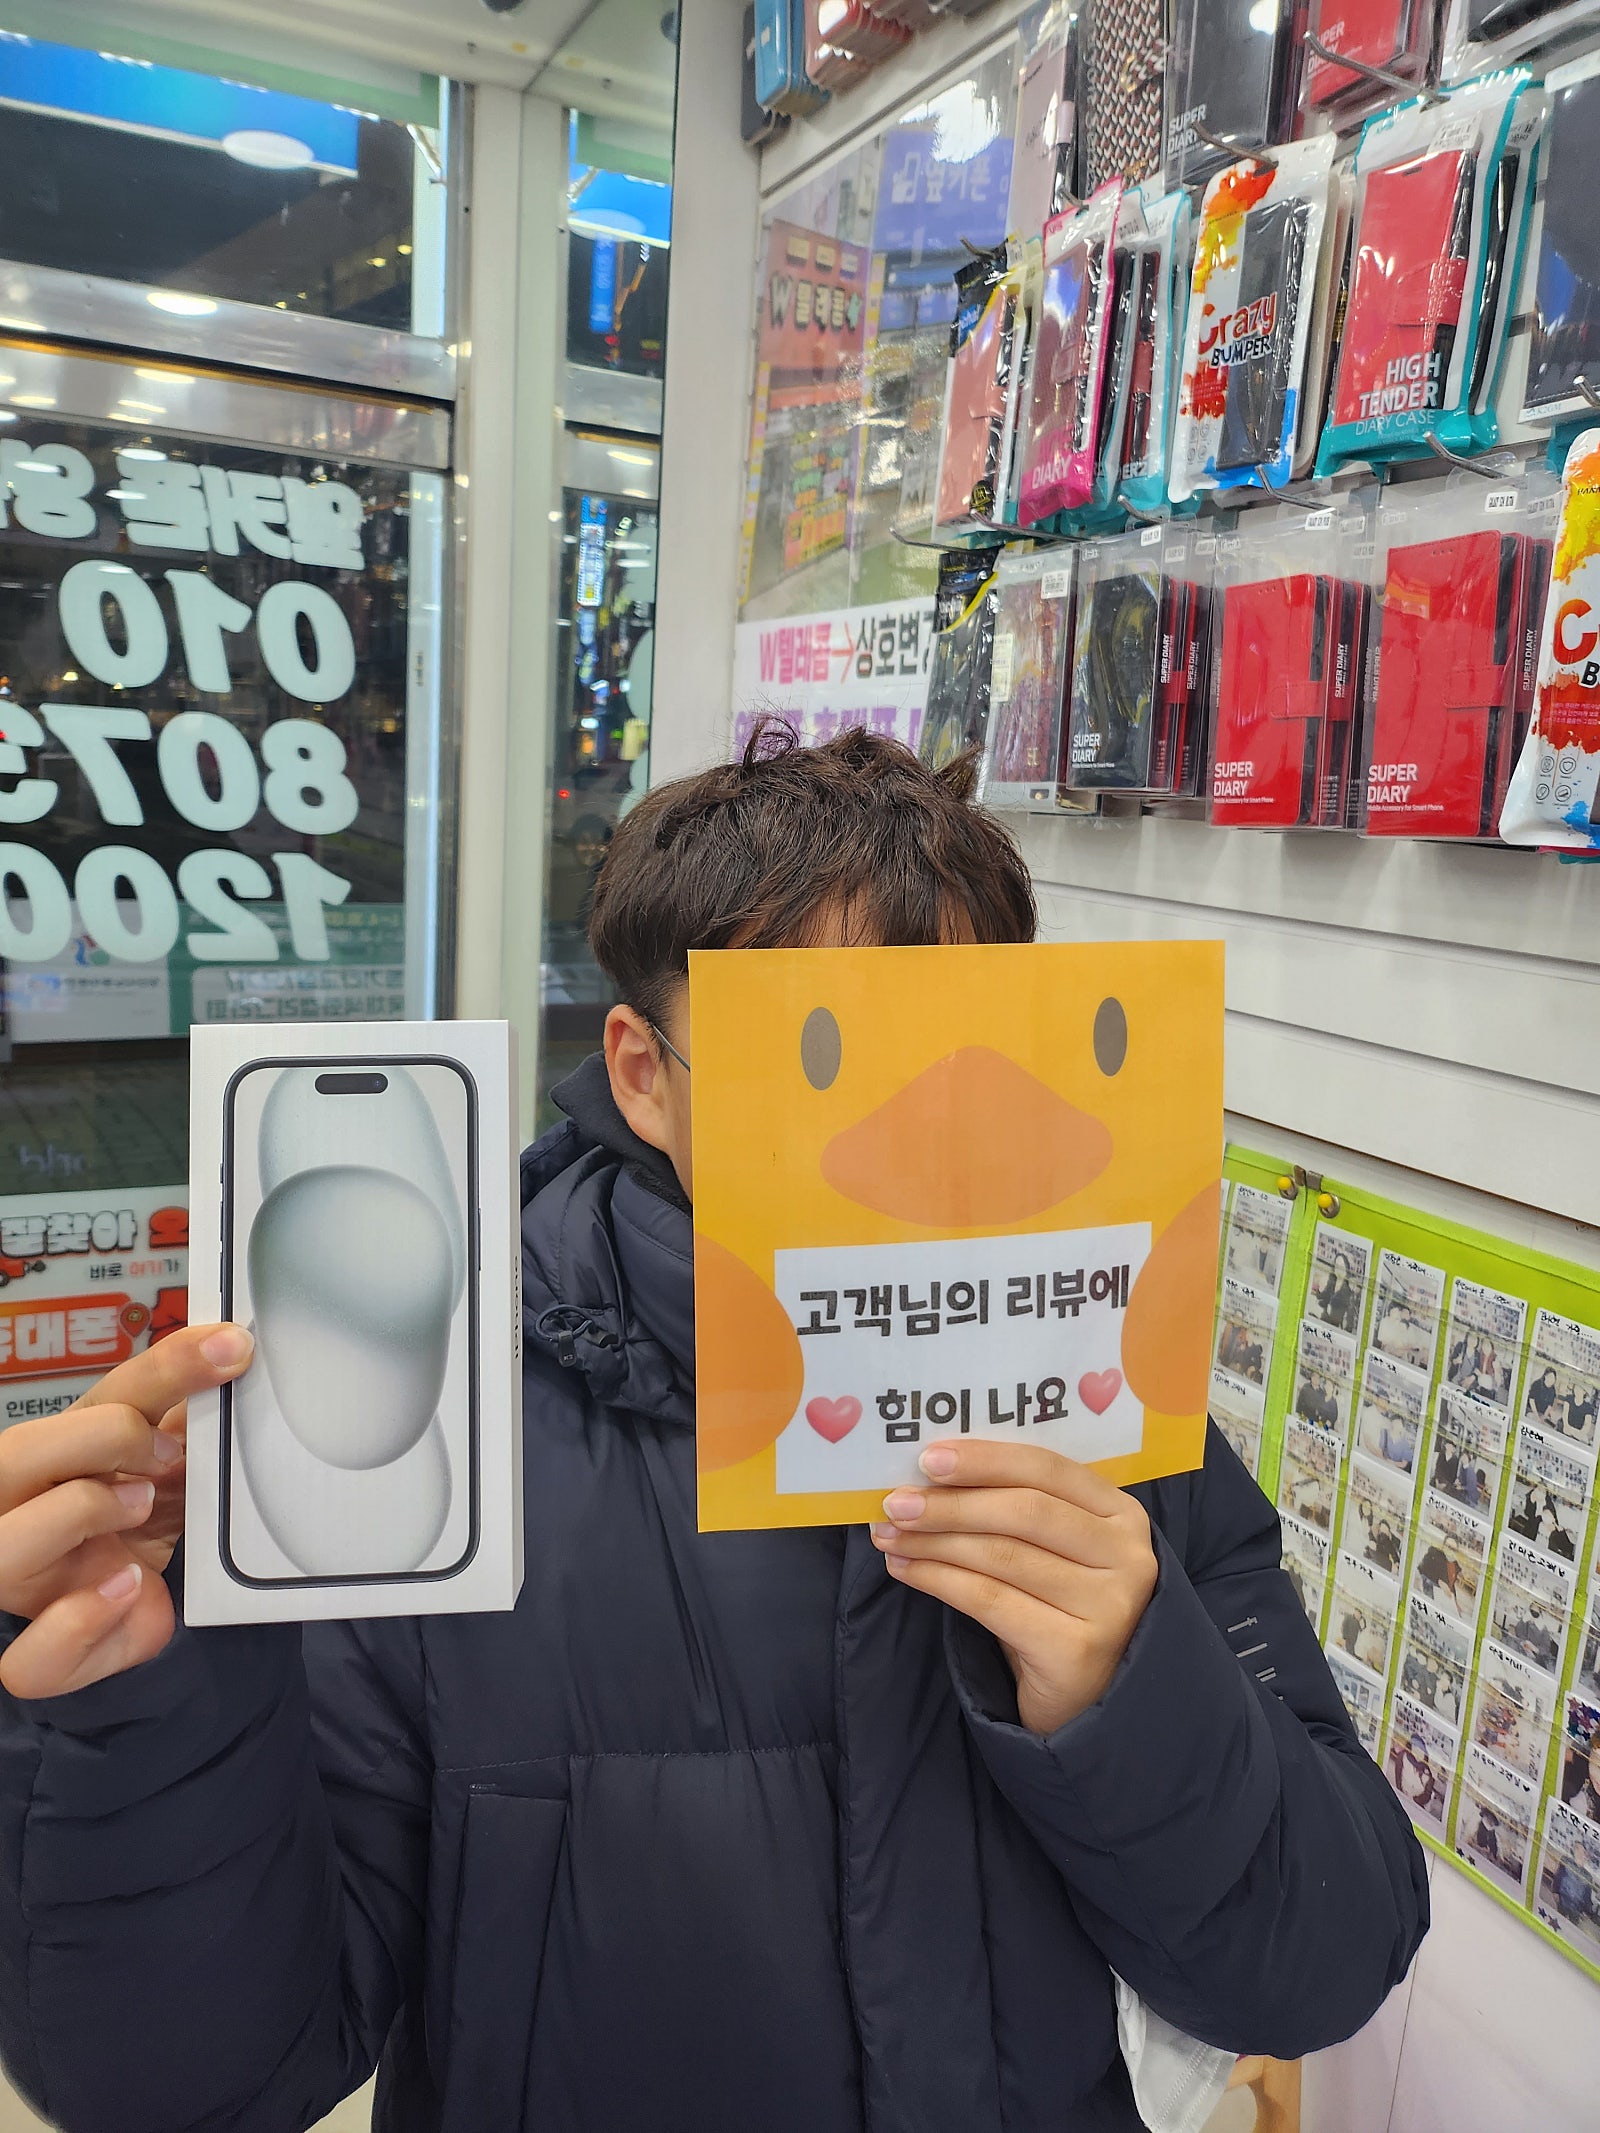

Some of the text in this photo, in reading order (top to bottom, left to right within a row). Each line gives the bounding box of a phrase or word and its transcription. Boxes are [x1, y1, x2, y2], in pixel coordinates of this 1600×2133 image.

[1316, 20, 1345, 47] UPER
[1168, 104, 1207, 136] SUPER
[1167, 128, 1199, 154] DIARY
[1197, 291, 1278, 354] Crazy
[1211, 335, 1272, 367] BUMPER
[1385, 351, 1442, 386] HIGH
[1358, 381, 1441, 418] TENDER
[1355, 415, 1392, 436] DIARY
[1395, 409, 1435, 428] CASE
[1032, 454, 1073, 489] DIARY
[1161, 633, 1171, 684] SUPER DIARY
[1523, 629, 1534, 691] SUPER DIARY
[1072, 749, 1097, 762] DIARY
[1073, 733, 1101, 748] SUPER
[1214, 761, 1254, 779] SUPER
[1368, 763, 1418, 782] SUPER
[1214, 780, 1248, 797] DIARY
[1367, 785, 1411, 803] DIARY
[90, 1262, 123, 1280] 바로
[797, 1264, 1130, 1336] 고객님의 리뷰에
[0, 1305, 118, 1364] 대폰
[876, 1376, 1069, 1443] 힘이 나요
